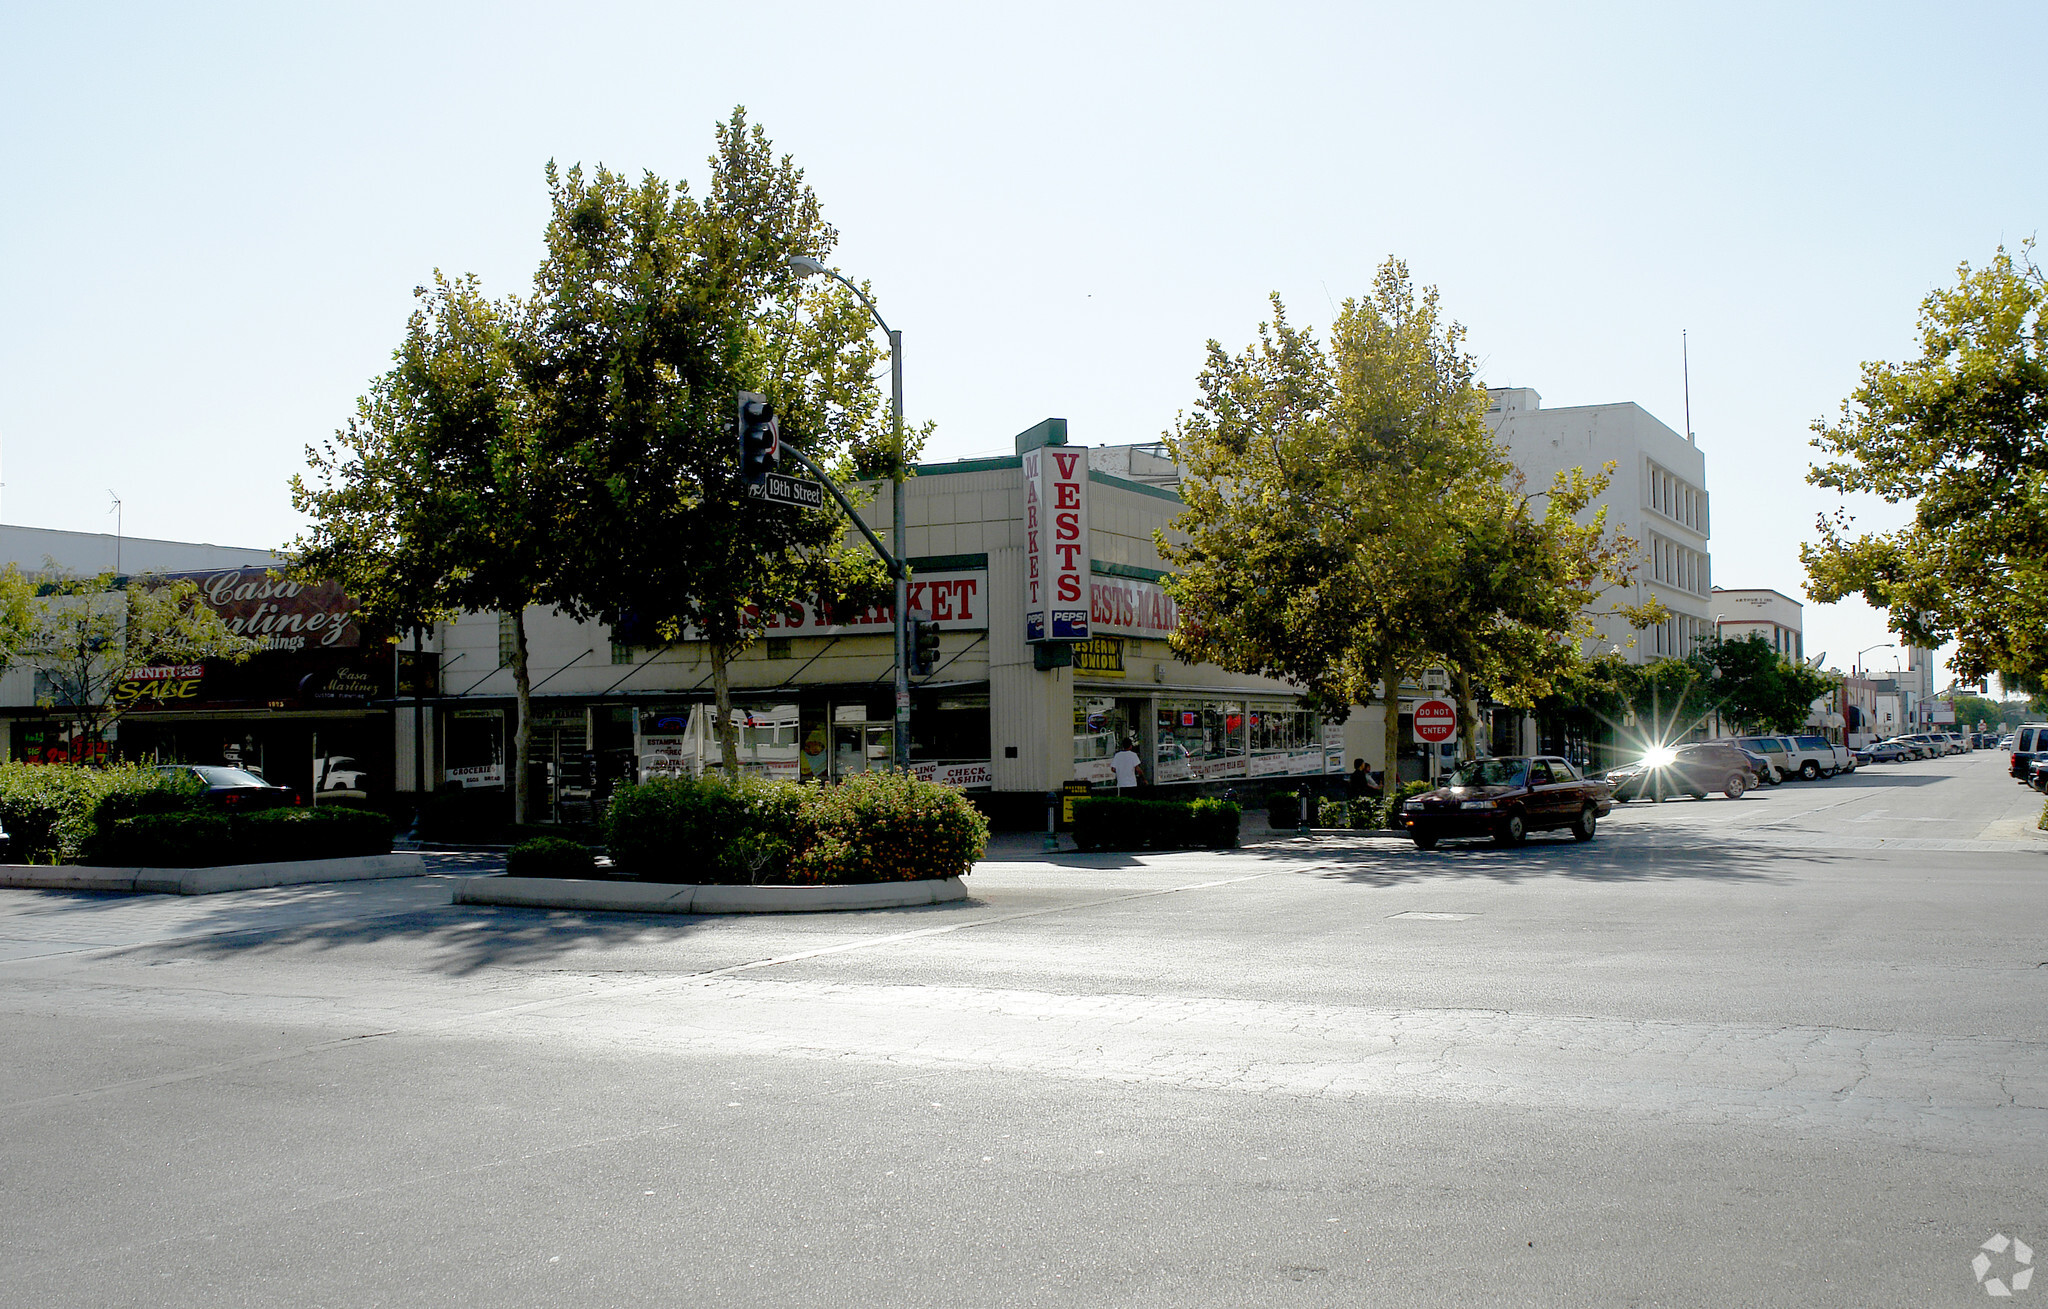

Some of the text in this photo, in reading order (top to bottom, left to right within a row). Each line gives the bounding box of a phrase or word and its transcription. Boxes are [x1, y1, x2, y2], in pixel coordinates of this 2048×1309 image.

[769, 478, 821, 504] 19th Street
[1025, 454, 1039, 604] MARKET
[1052, 453, 1082, 602] VESTS
[203, 571, 304, 606] Casa
[1091, 583, 1133, 627] ESTS
[167, 604, 350, 646] rtinez
[1027, 613, 1043, 625] PEPSI
[1054, 612, 1087, 622] PEPSI
[1075, 639, 1118, 654] ESTERN
[1081, 653, 1117, 669] UNION
[125, 664, 203, 680] URNITURE
[336, 667, 368, 680] Casa
[114, 679, 202, 700] SALE
[323, 678, 379, 696] Martinez
[1419, 708, 1450, 716] DO NOT
[1422, 727, 1447, 735] ENTER
[914, 765, 936, 775] LING
[916, 774, 933, 782] RDS
[947, 767, 986, 777] CHECK
